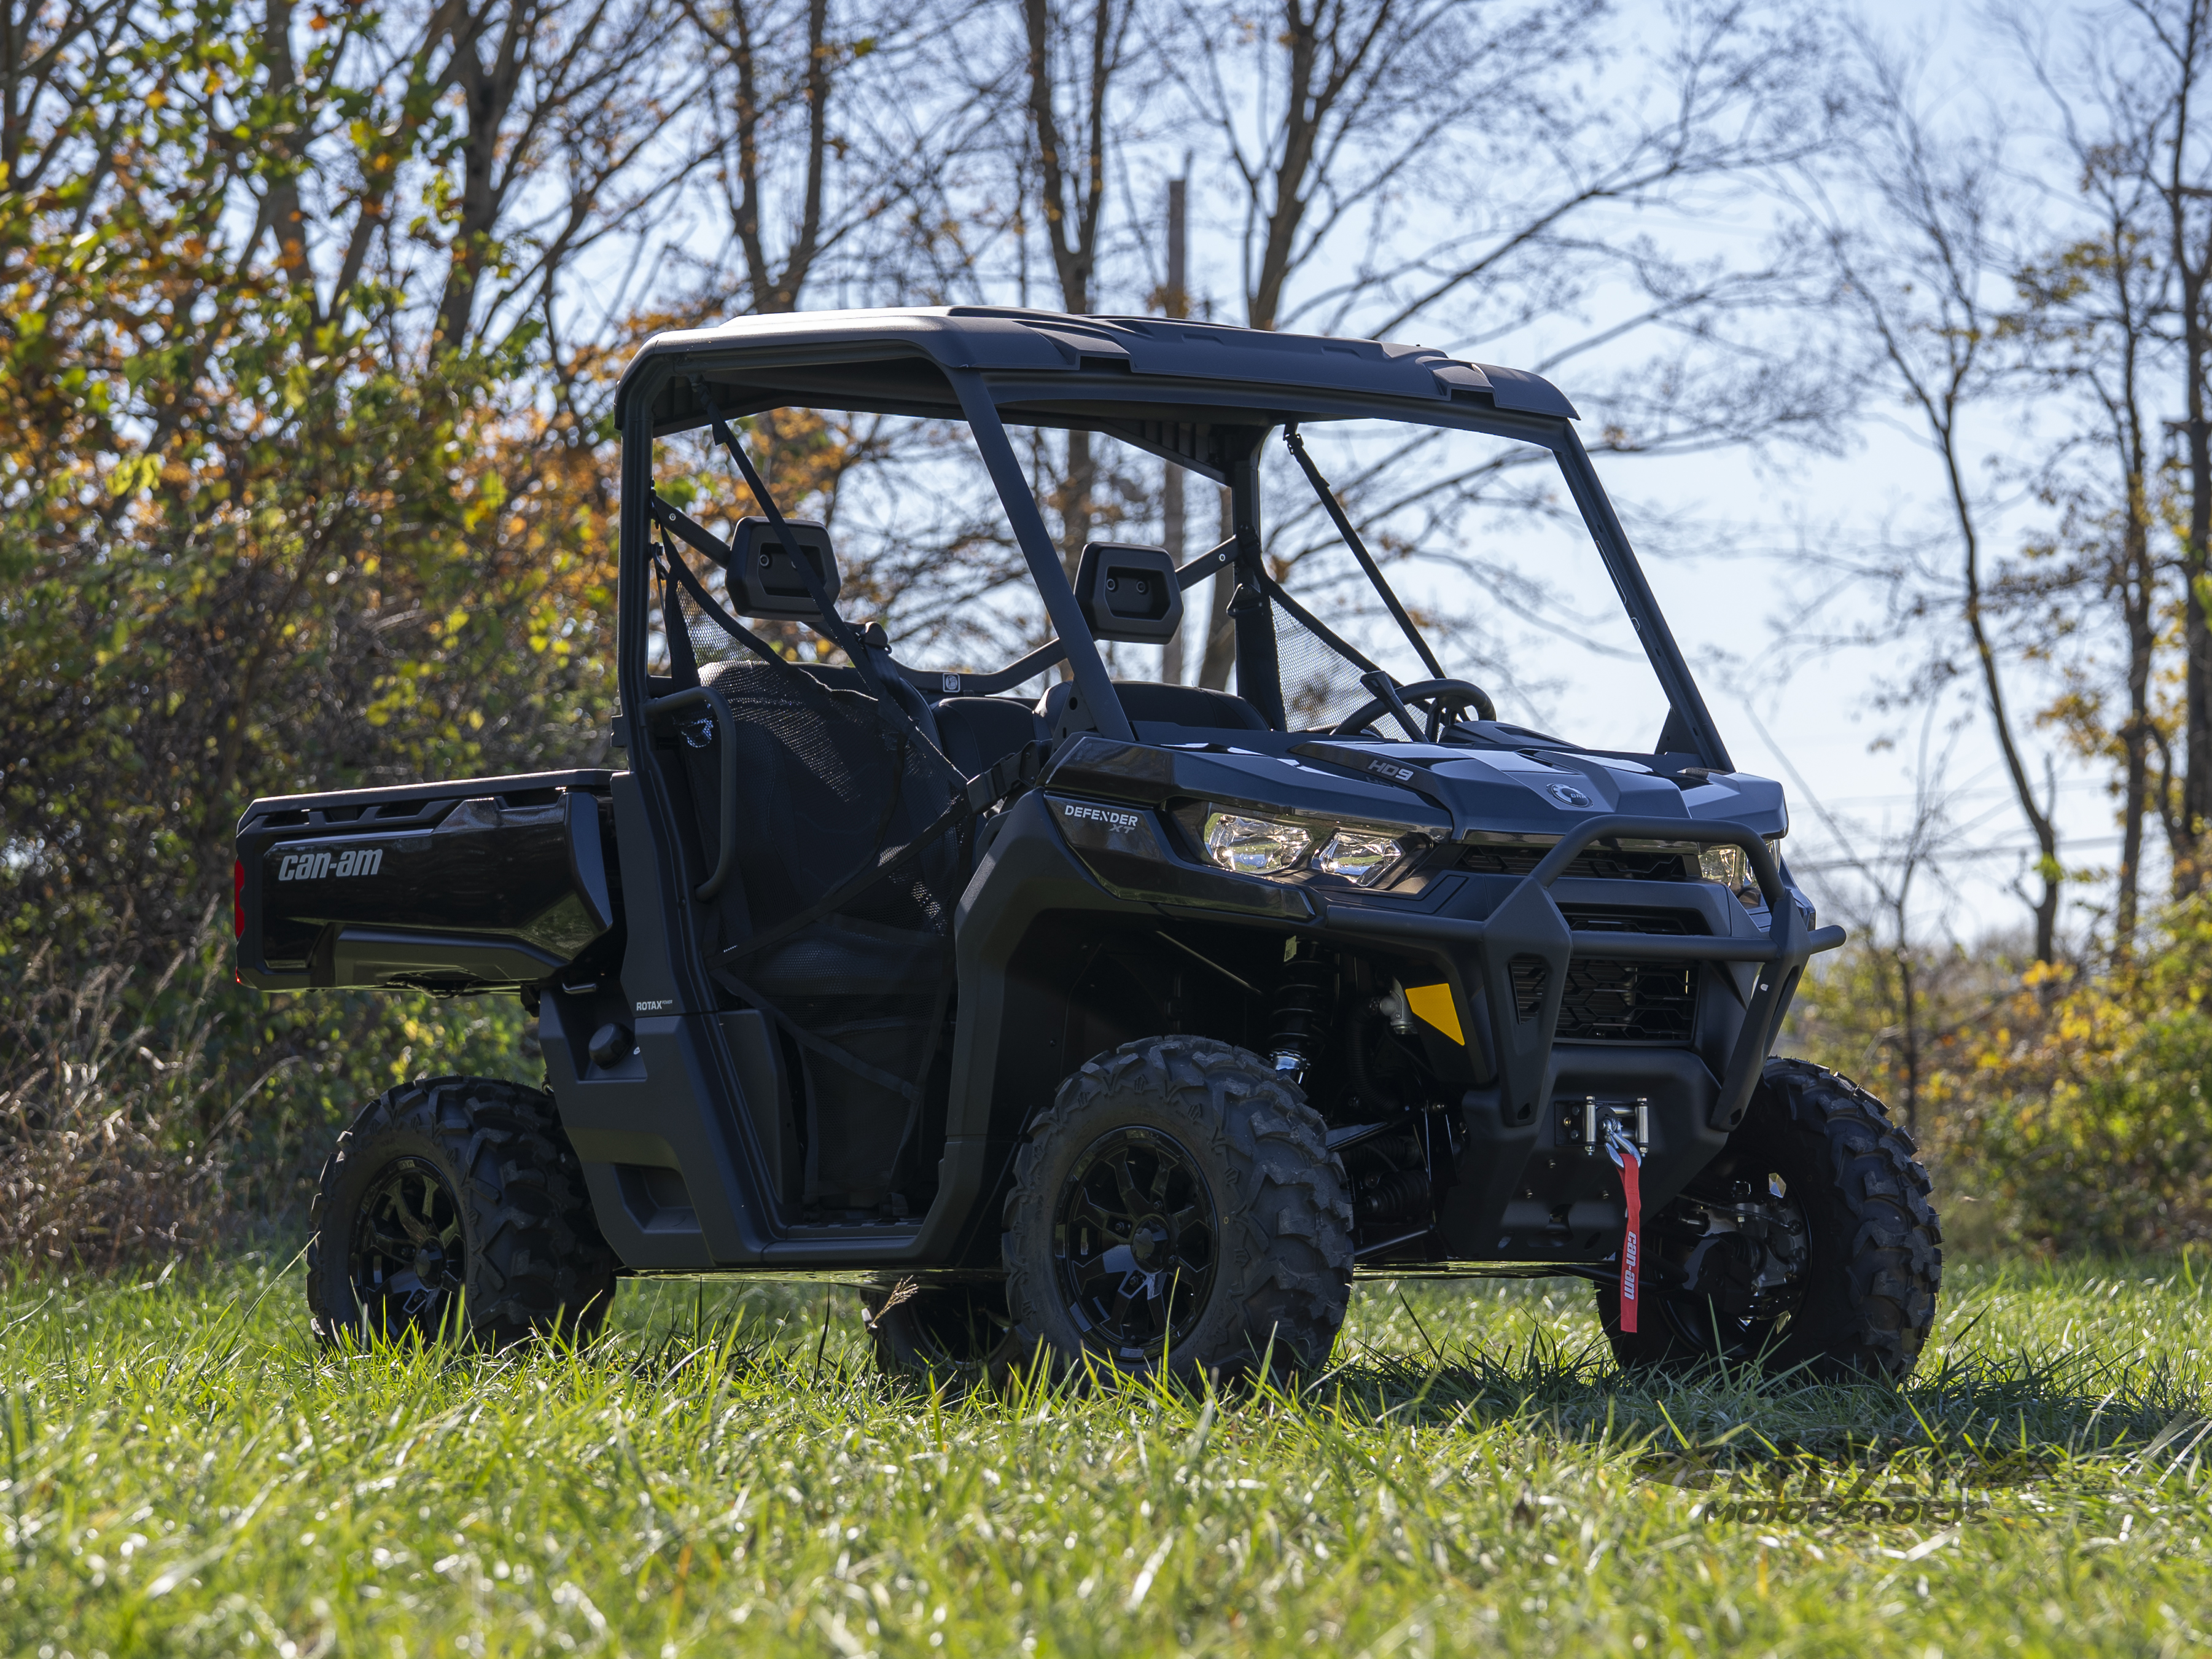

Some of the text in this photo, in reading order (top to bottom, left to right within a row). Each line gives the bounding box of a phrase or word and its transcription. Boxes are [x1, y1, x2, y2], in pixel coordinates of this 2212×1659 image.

[1368, 760, 1414, 781] HD9
[1064, 805, 1138, 826] DEFENDER
[1109, 824, 1135, 833] XT
[278, 848, 383, 881] can-am
[636, 1001, 662, 1011] ROTAX
[1624, 1230, 1637, 1300] can-am
